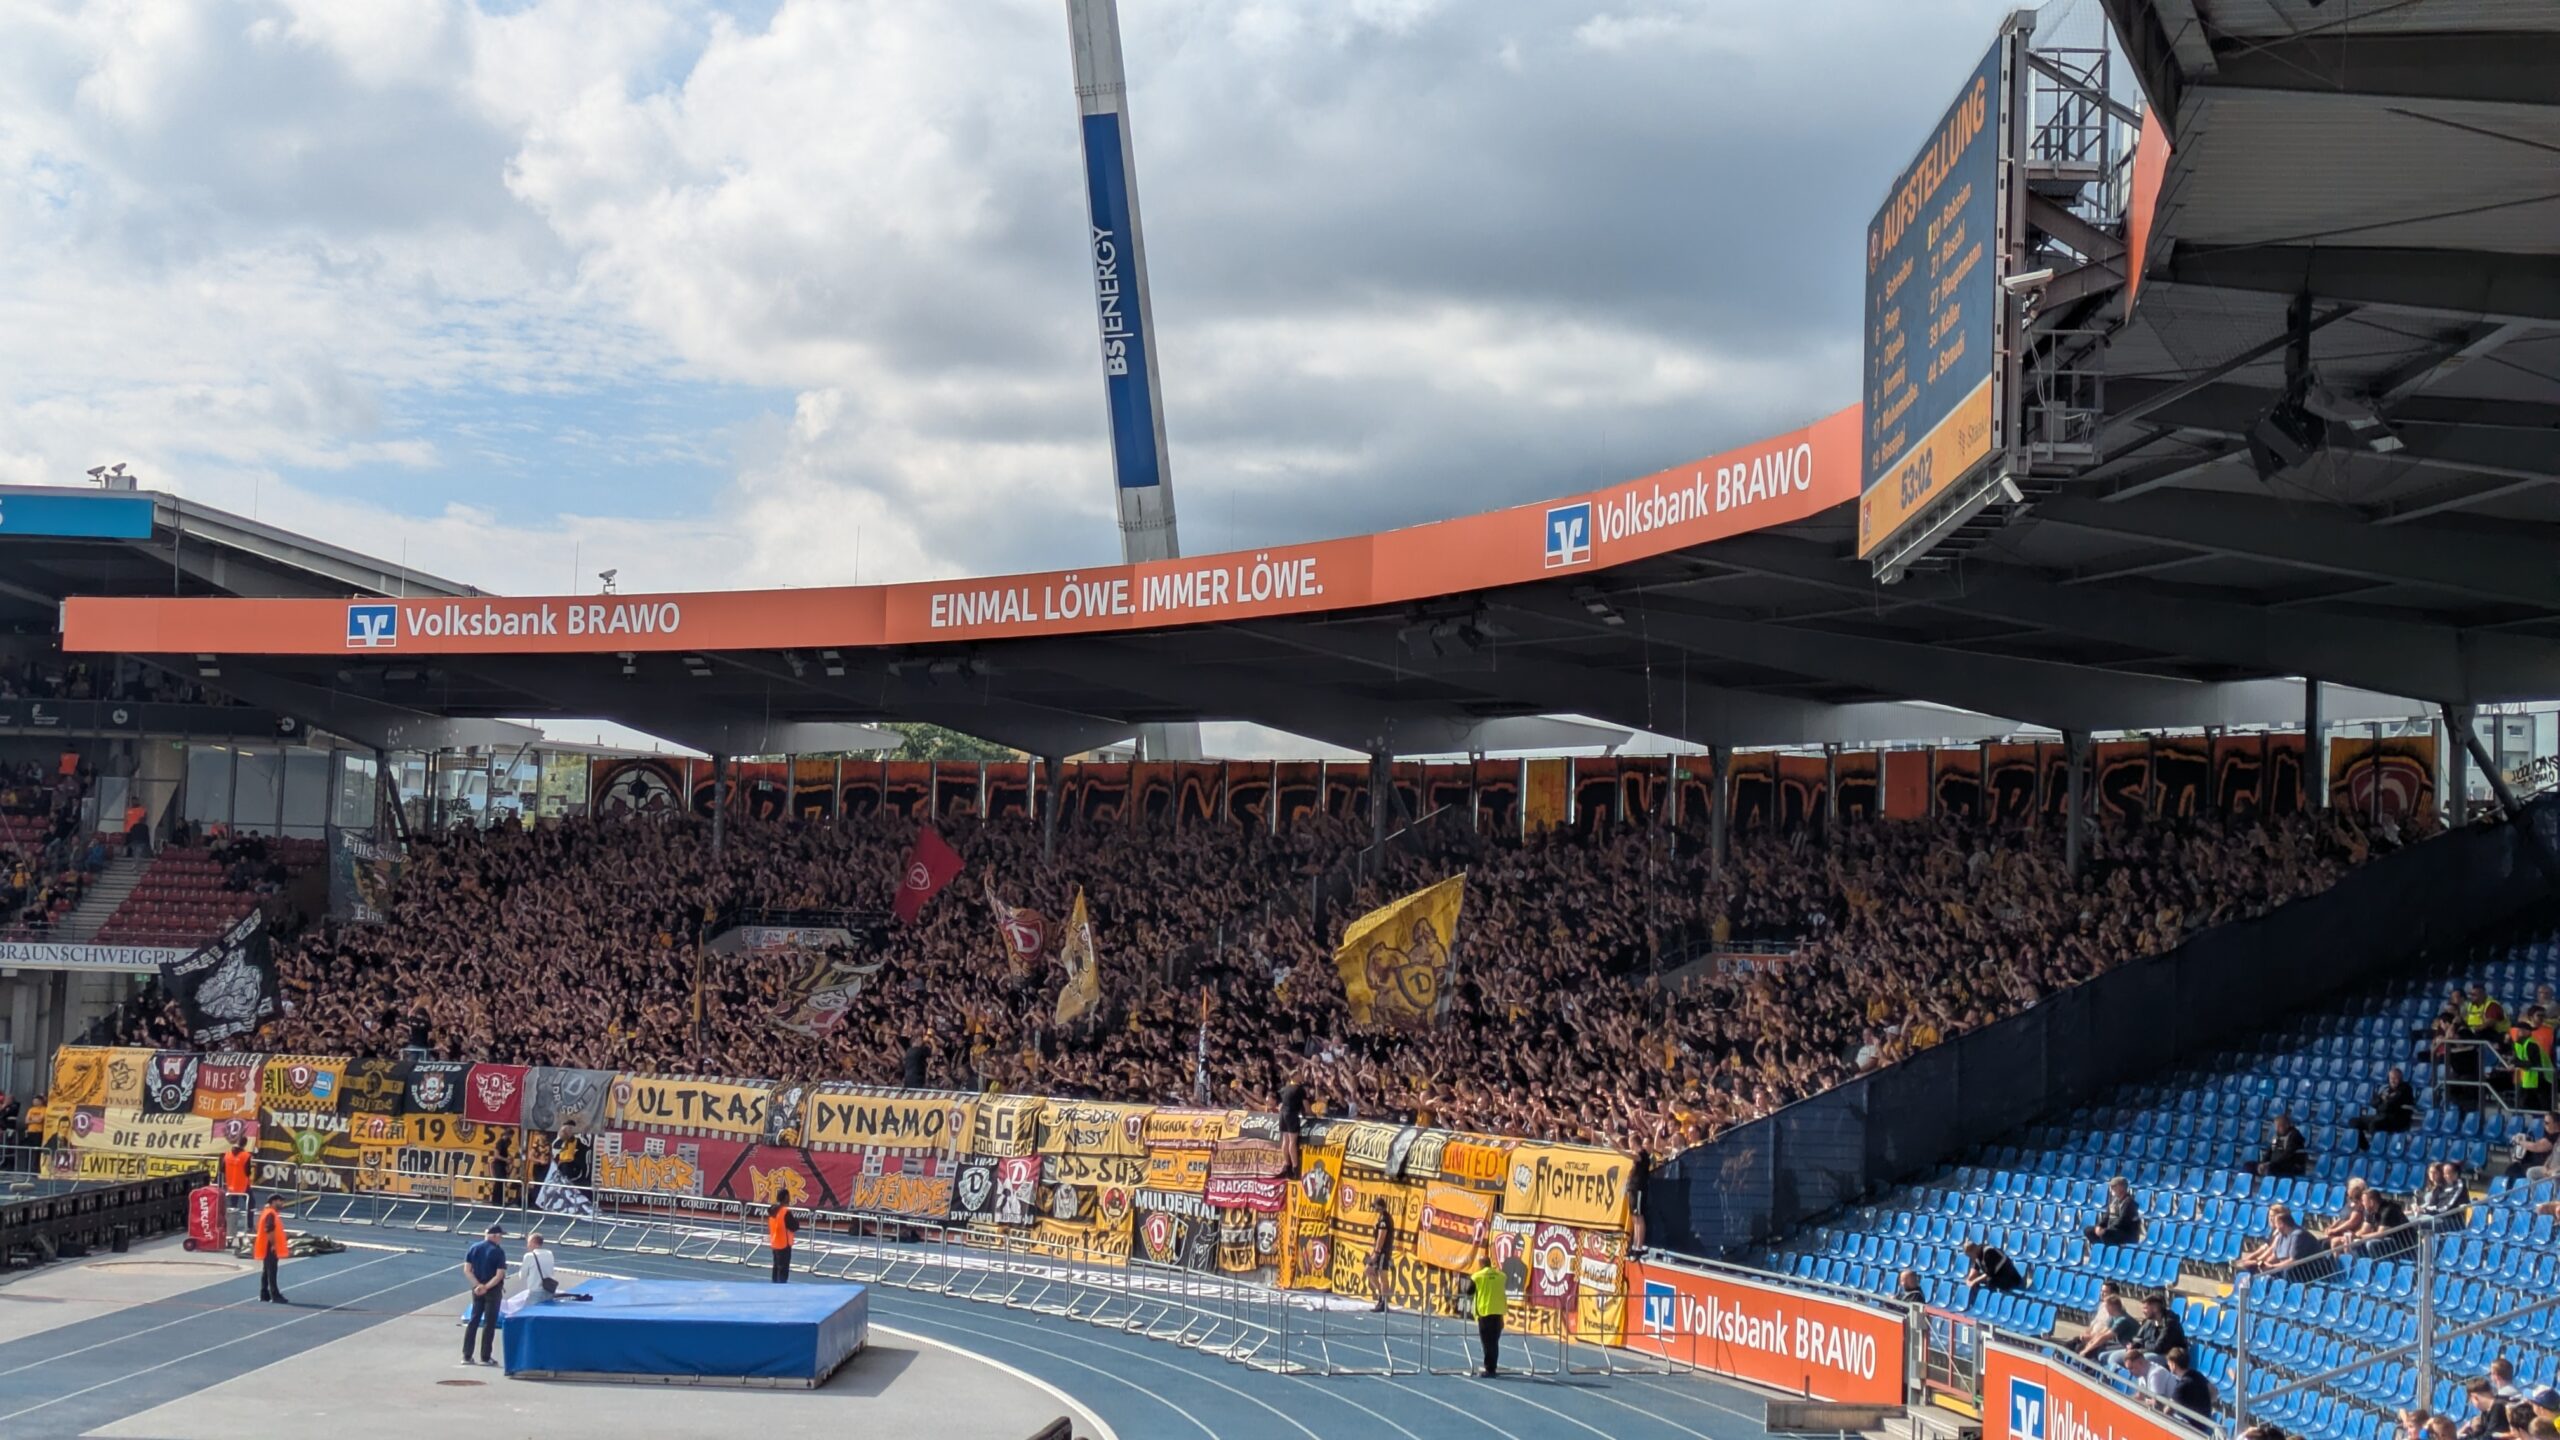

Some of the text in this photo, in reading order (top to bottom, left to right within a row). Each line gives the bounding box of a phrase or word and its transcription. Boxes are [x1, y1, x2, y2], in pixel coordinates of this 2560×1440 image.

[1881, 76, 1986, 260] AUFSTELLUNG
[1942, 241, 1982, 301] Hauptmann
[1901, 447, 1933, 510] 53:02
[1598, 443, 1812, 543] Volksbank BRAWO
[931, 553, 1324, 628] EINMAL LÖWE. IMMER LÖWE.
[406, 603, 680, 637] Volksbank BRAWO
[203, 1052, 263, 1067] SCHNELLER
[205, 1070, 236, 1090] HASE
[292, 1066, 308, 1084] D
[564, 1075, 585, 1095] D
[198, 1095, 216, 1112] SEIT
[616, 1085, 629, 1103] D
[637, 1086, 765, 1126] ULTRAS
[1057, 1108, 1122, 1125] DRESDEN
[75, 1114, 89, 1130] D
[228, 1120, 242, 1135] D
[270, 1111, 350, 1133] FREITAL
[415, 1118, 446, 1143] 19
[817, 1101, 944, 1138] DYNAMO
[949, 1111, 962, 1132] D
[1126, 1116, 1141, 1138] D
[113, 1129, 203, 1149] DIE BÖCKE
[601, 1149, 696, 1191] KINDER
[1443, 1142, 1499, 1178] UNITED
[263, 1164, 290, 1182] ON
[1008, 1161, 1027, 1185] D
[1536, 1156, 1619, 1212] FIGHTERS
[750, 1165, 809, 1206] DER
[853, 1170, 949, 1217] WENDE
[1216, 1180, 1275, 1198] RADEBURG
[1344, 1186, 1354, 1204] D
[1135, 1189, 1221, 1220] MULDENTAL
[950, 1211, 992, 1222] DYNAMO
[1151, 1218, 1166, 1248] D
[1299, 1221, 1329, 1237] ZEITZ
[1312, 1243, 1325, 1265] D
[1540, 1274, 1569, 1296] Dynamo
[1680, 1292, 1876, 1380] Volksbank BRAWO
